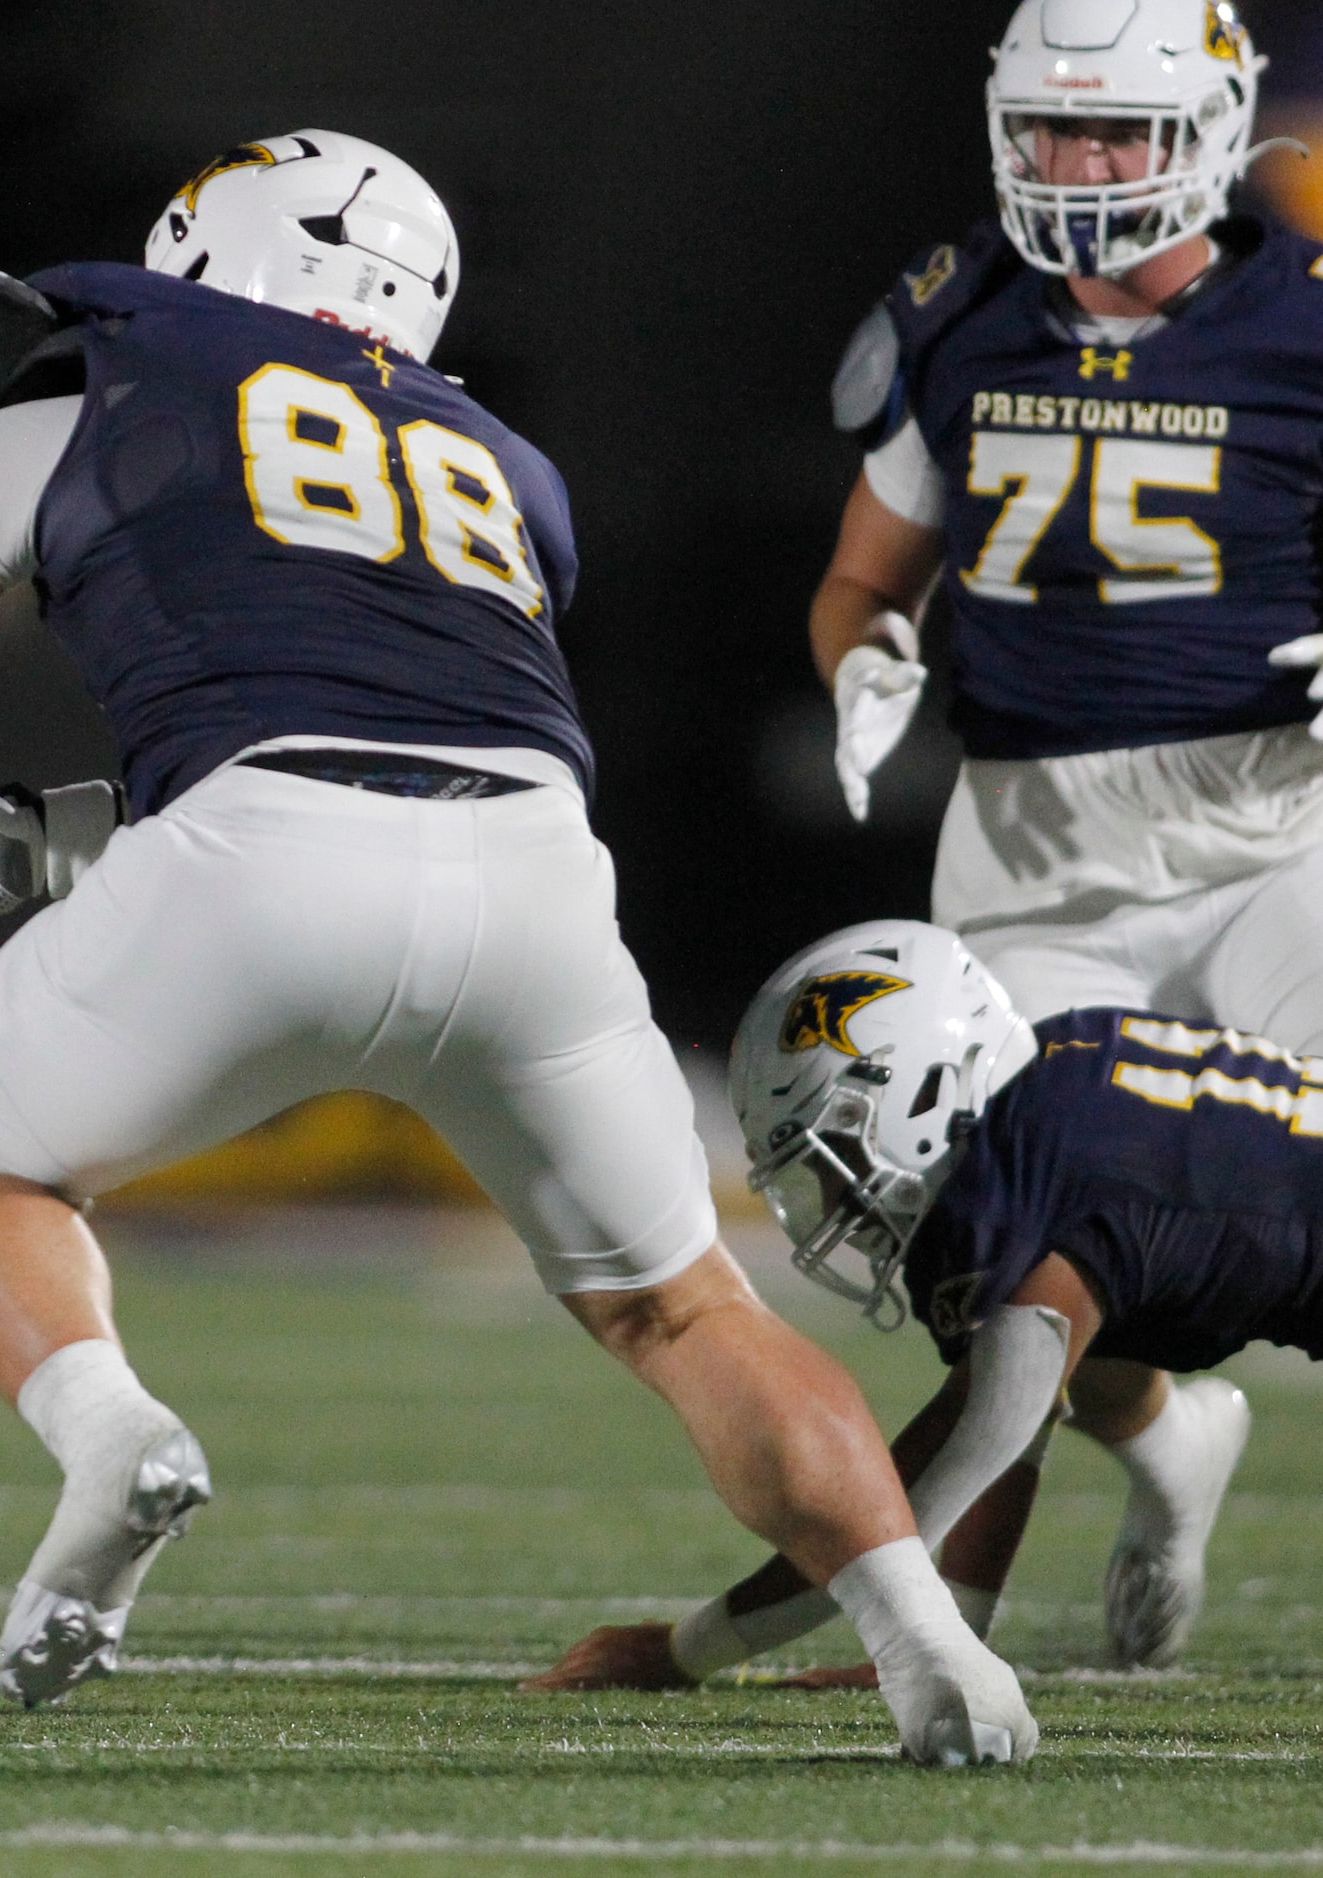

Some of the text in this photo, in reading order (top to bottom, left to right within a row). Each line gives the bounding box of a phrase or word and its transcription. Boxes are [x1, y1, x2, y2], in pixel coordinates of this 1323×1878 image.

[238, 362, 543, 618] 88
[972, 391, 1229, 437] PRESTONWOOD
[959, 432, 1222, 604] 75
